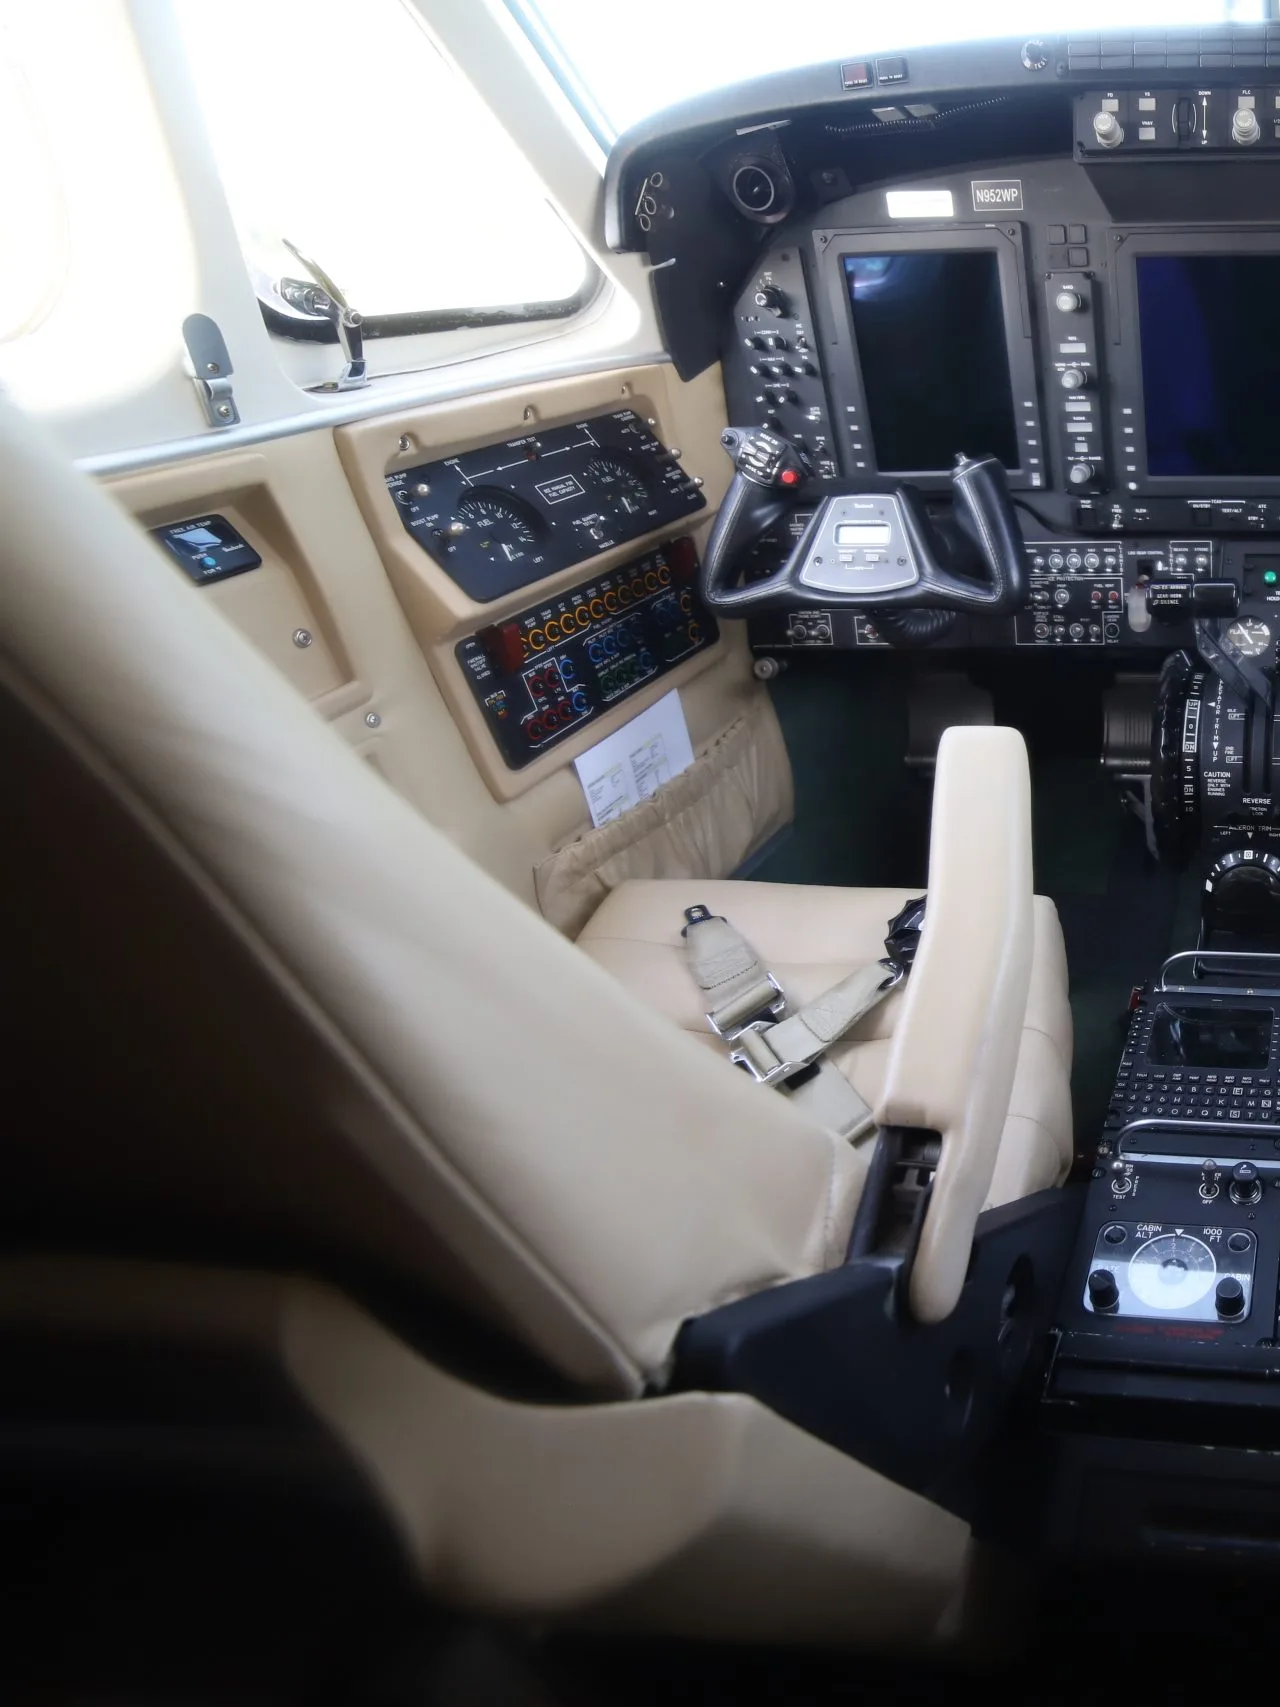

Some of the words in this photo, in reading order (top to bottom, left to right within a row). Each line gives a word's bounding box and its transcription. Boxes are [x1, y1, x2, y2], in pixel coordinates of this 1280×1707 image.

[976, 188, 1019, 203] N952WP
[477, 518, 494, 528] FUEL
[1137, 1224, 1162, 1232] CABIN
